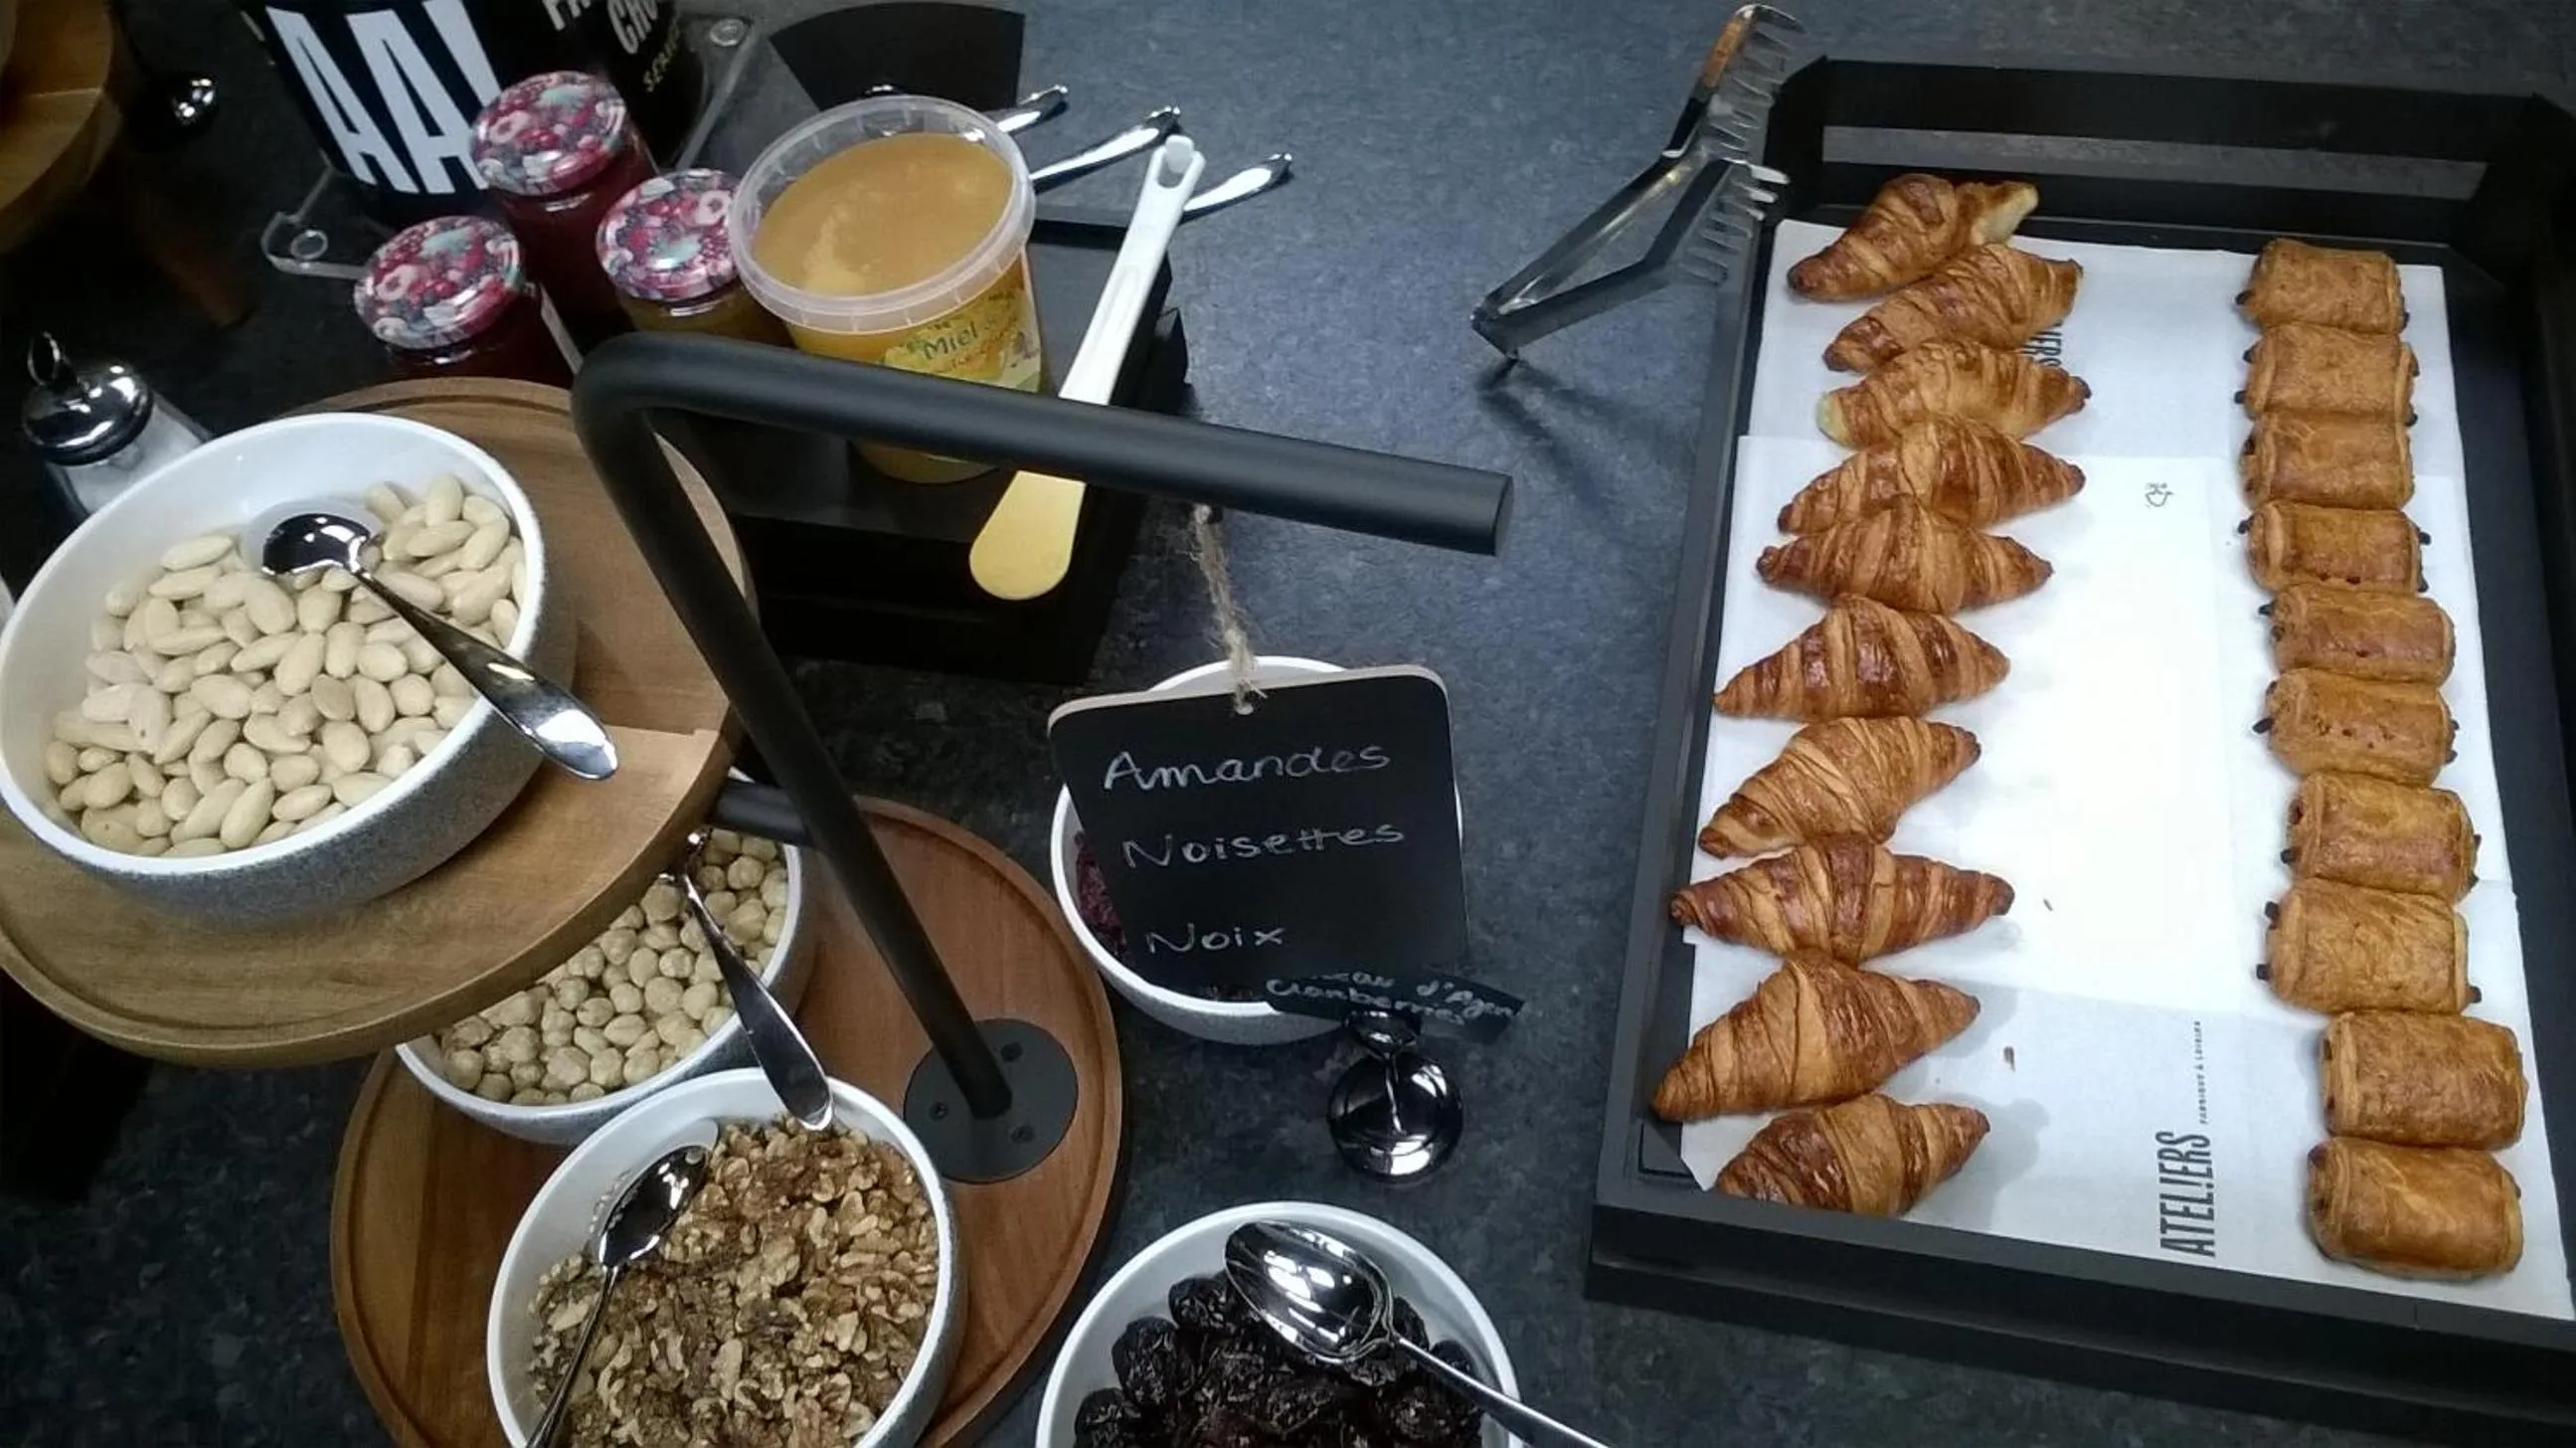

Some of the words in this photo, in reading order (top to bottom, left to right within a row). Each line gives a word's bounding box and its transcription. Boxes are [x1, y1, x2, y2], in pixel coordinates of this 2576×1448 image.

[923, 321, 979, 360] Miel
[1104, 746, 1390, 790] Amandes
[1121, 822, 1405, 868] Noisettes
[1147, 923, 1287, 955] Noix
